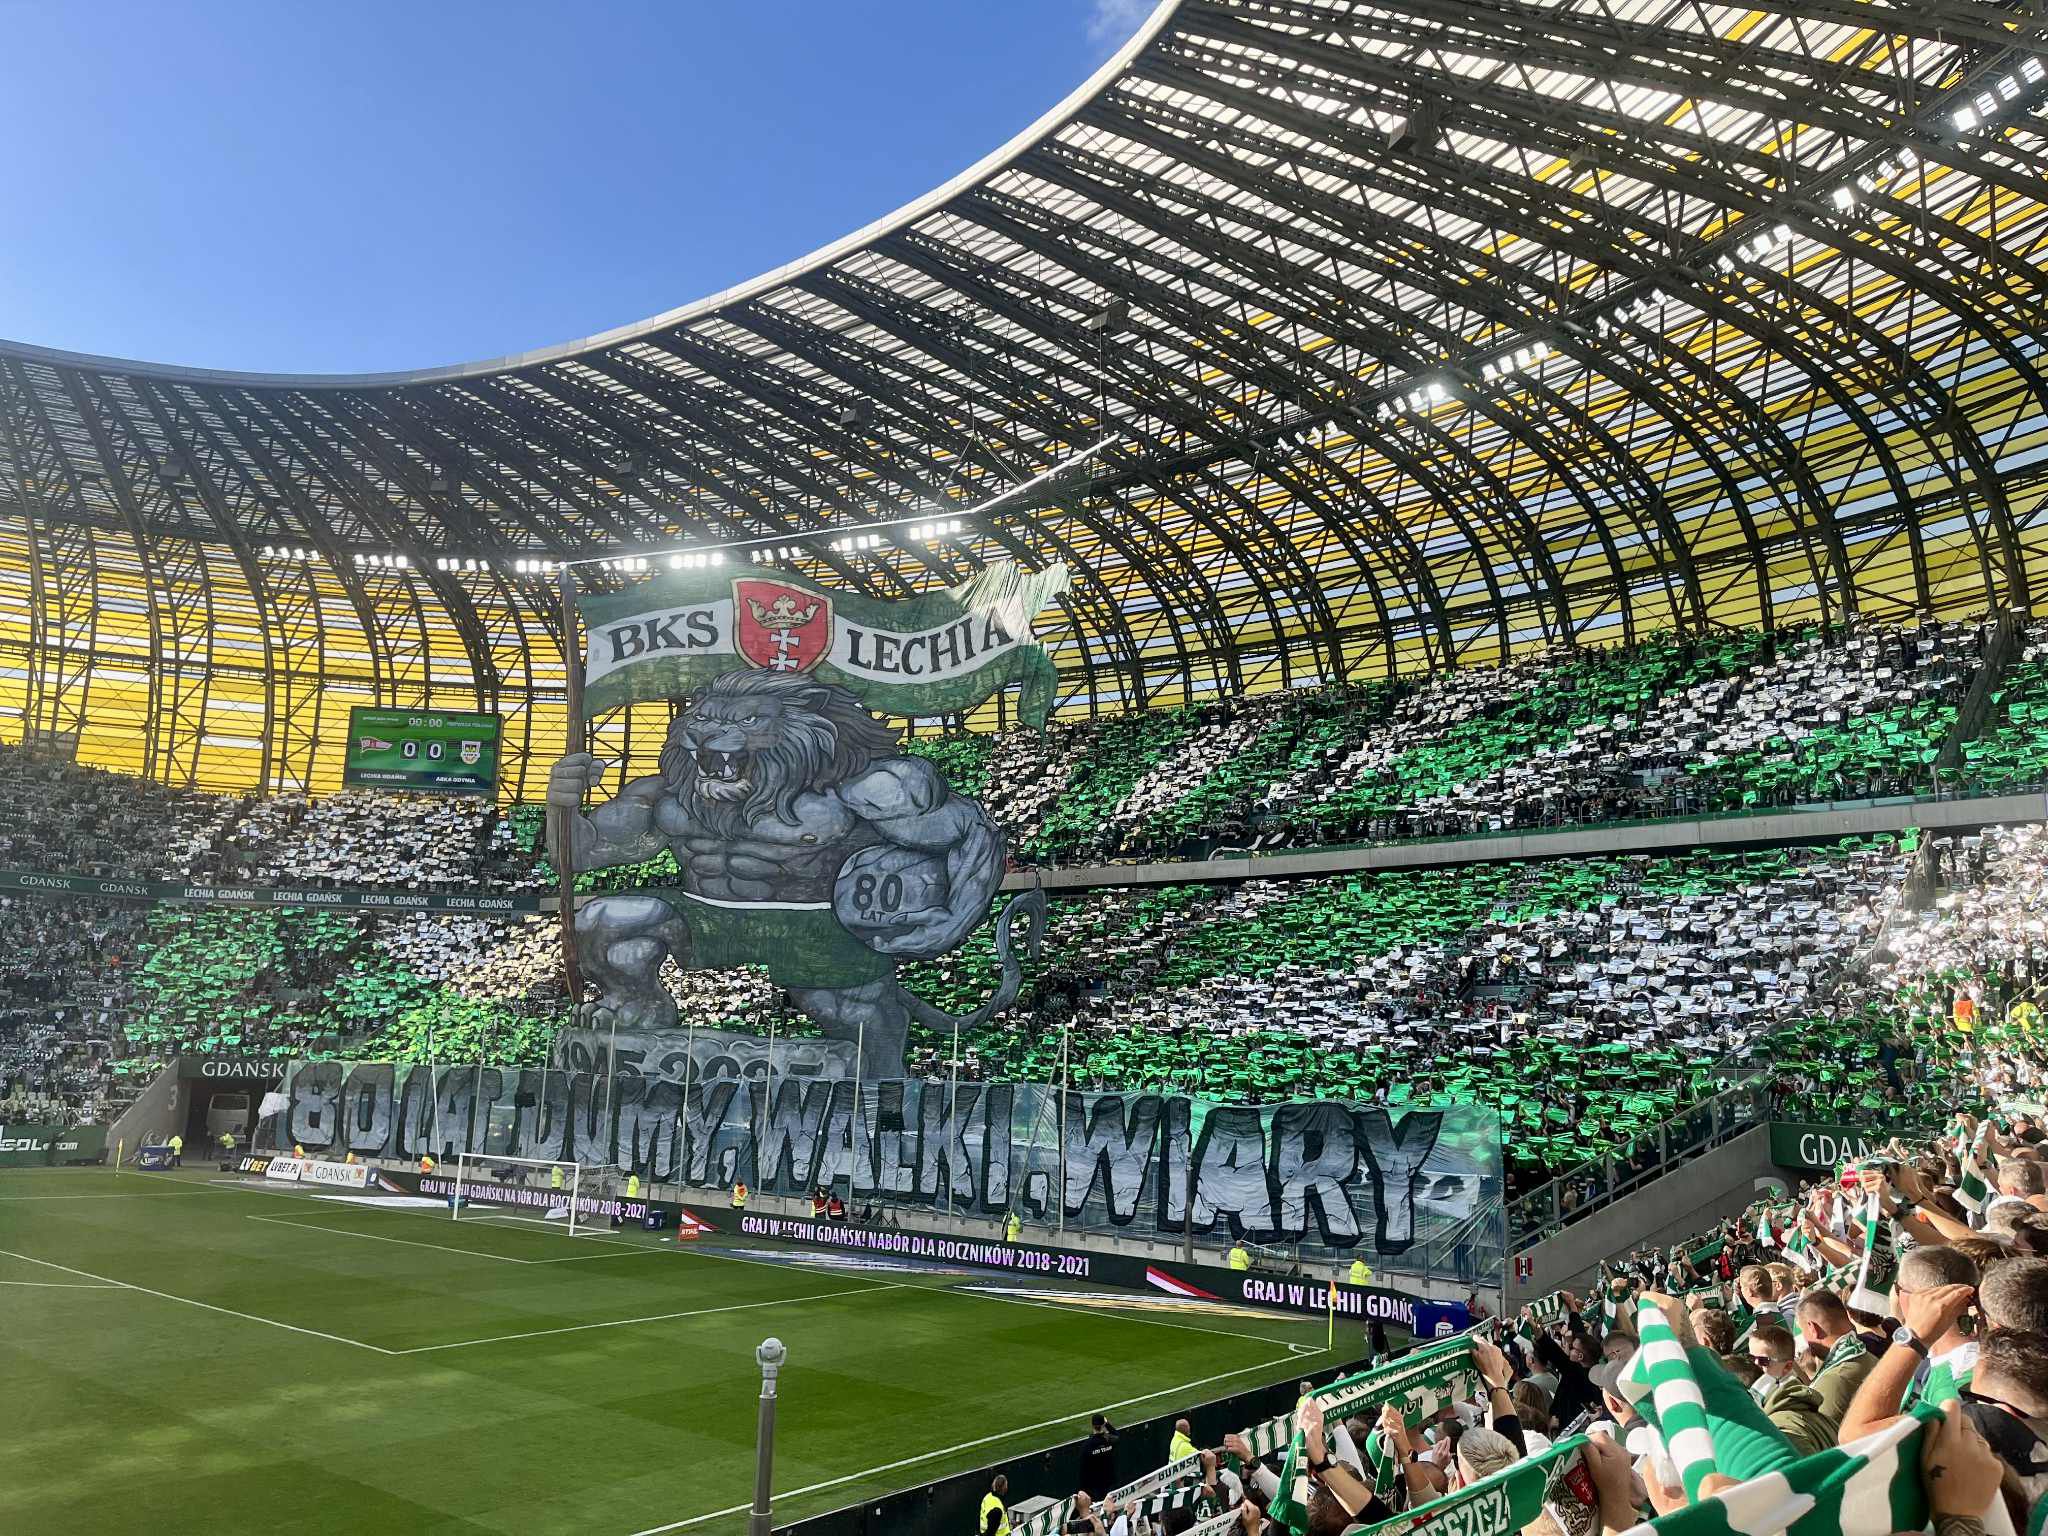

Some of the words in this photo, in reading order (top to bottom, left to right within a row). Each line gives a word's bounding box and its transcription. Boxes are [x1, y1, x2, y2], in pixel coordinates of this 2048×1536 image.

[607, 610, 719, 664] BKS
[846, 610, 1014, 677] LECHIA
[403, 742, 417, 757] 0
[429, 743, 442, 758] 0
[20, 874, 72, 889] GDAŃSK
[99, 882, 149, 896] GDAŃSK
[184, 888, 214, 899] LECHIA
[218, 887, 255, 900] GDAŃSK
[273, 891, 303, 901] LECHIA
[306, 891, 342, 903] GDAŃSK
[360, 894, 390, 905] LECHIA
[393, 894, 429, 906] GDAŃSK
[853, 873, 903, 913] 80
[446, 897, 475, 908] LECHIA
[478, 898, 514, 909] GDAŃSK
[201, 1058, 285, 1078] GDAŃSK
[286, 1060, 398, 1156] 80
[1054, 1093, 1446, 1256] WIARY
[419, 1178, 439, 1193] GRAJ
[439, 1181, 447, 1194] W
[447, 1182, 470, 1196] LEHII
[532, 1193, 548, 1207] DLA
[549, 1194, 599, 1213] ROCZIKÓW
[600, 1200, 647, 1219] 2018-2021
[741, 1216, 768, 1235] GRAJ
[769, 1219, 780, 1236] W
[816, 1225, 866, 1247] GDAŃSK!
[868, 1230, 910, 1253] NABÓR
[911, 1237, 935, 1256] DLA
[938, 1240, 1015, 1268] ROCZNIKÓW
[1016, 1249, 1090, 1277] 2018-2021
[1243, 1278, 1284, 1303] GRAJ
[1287, 1283, 1304, 1306] W
